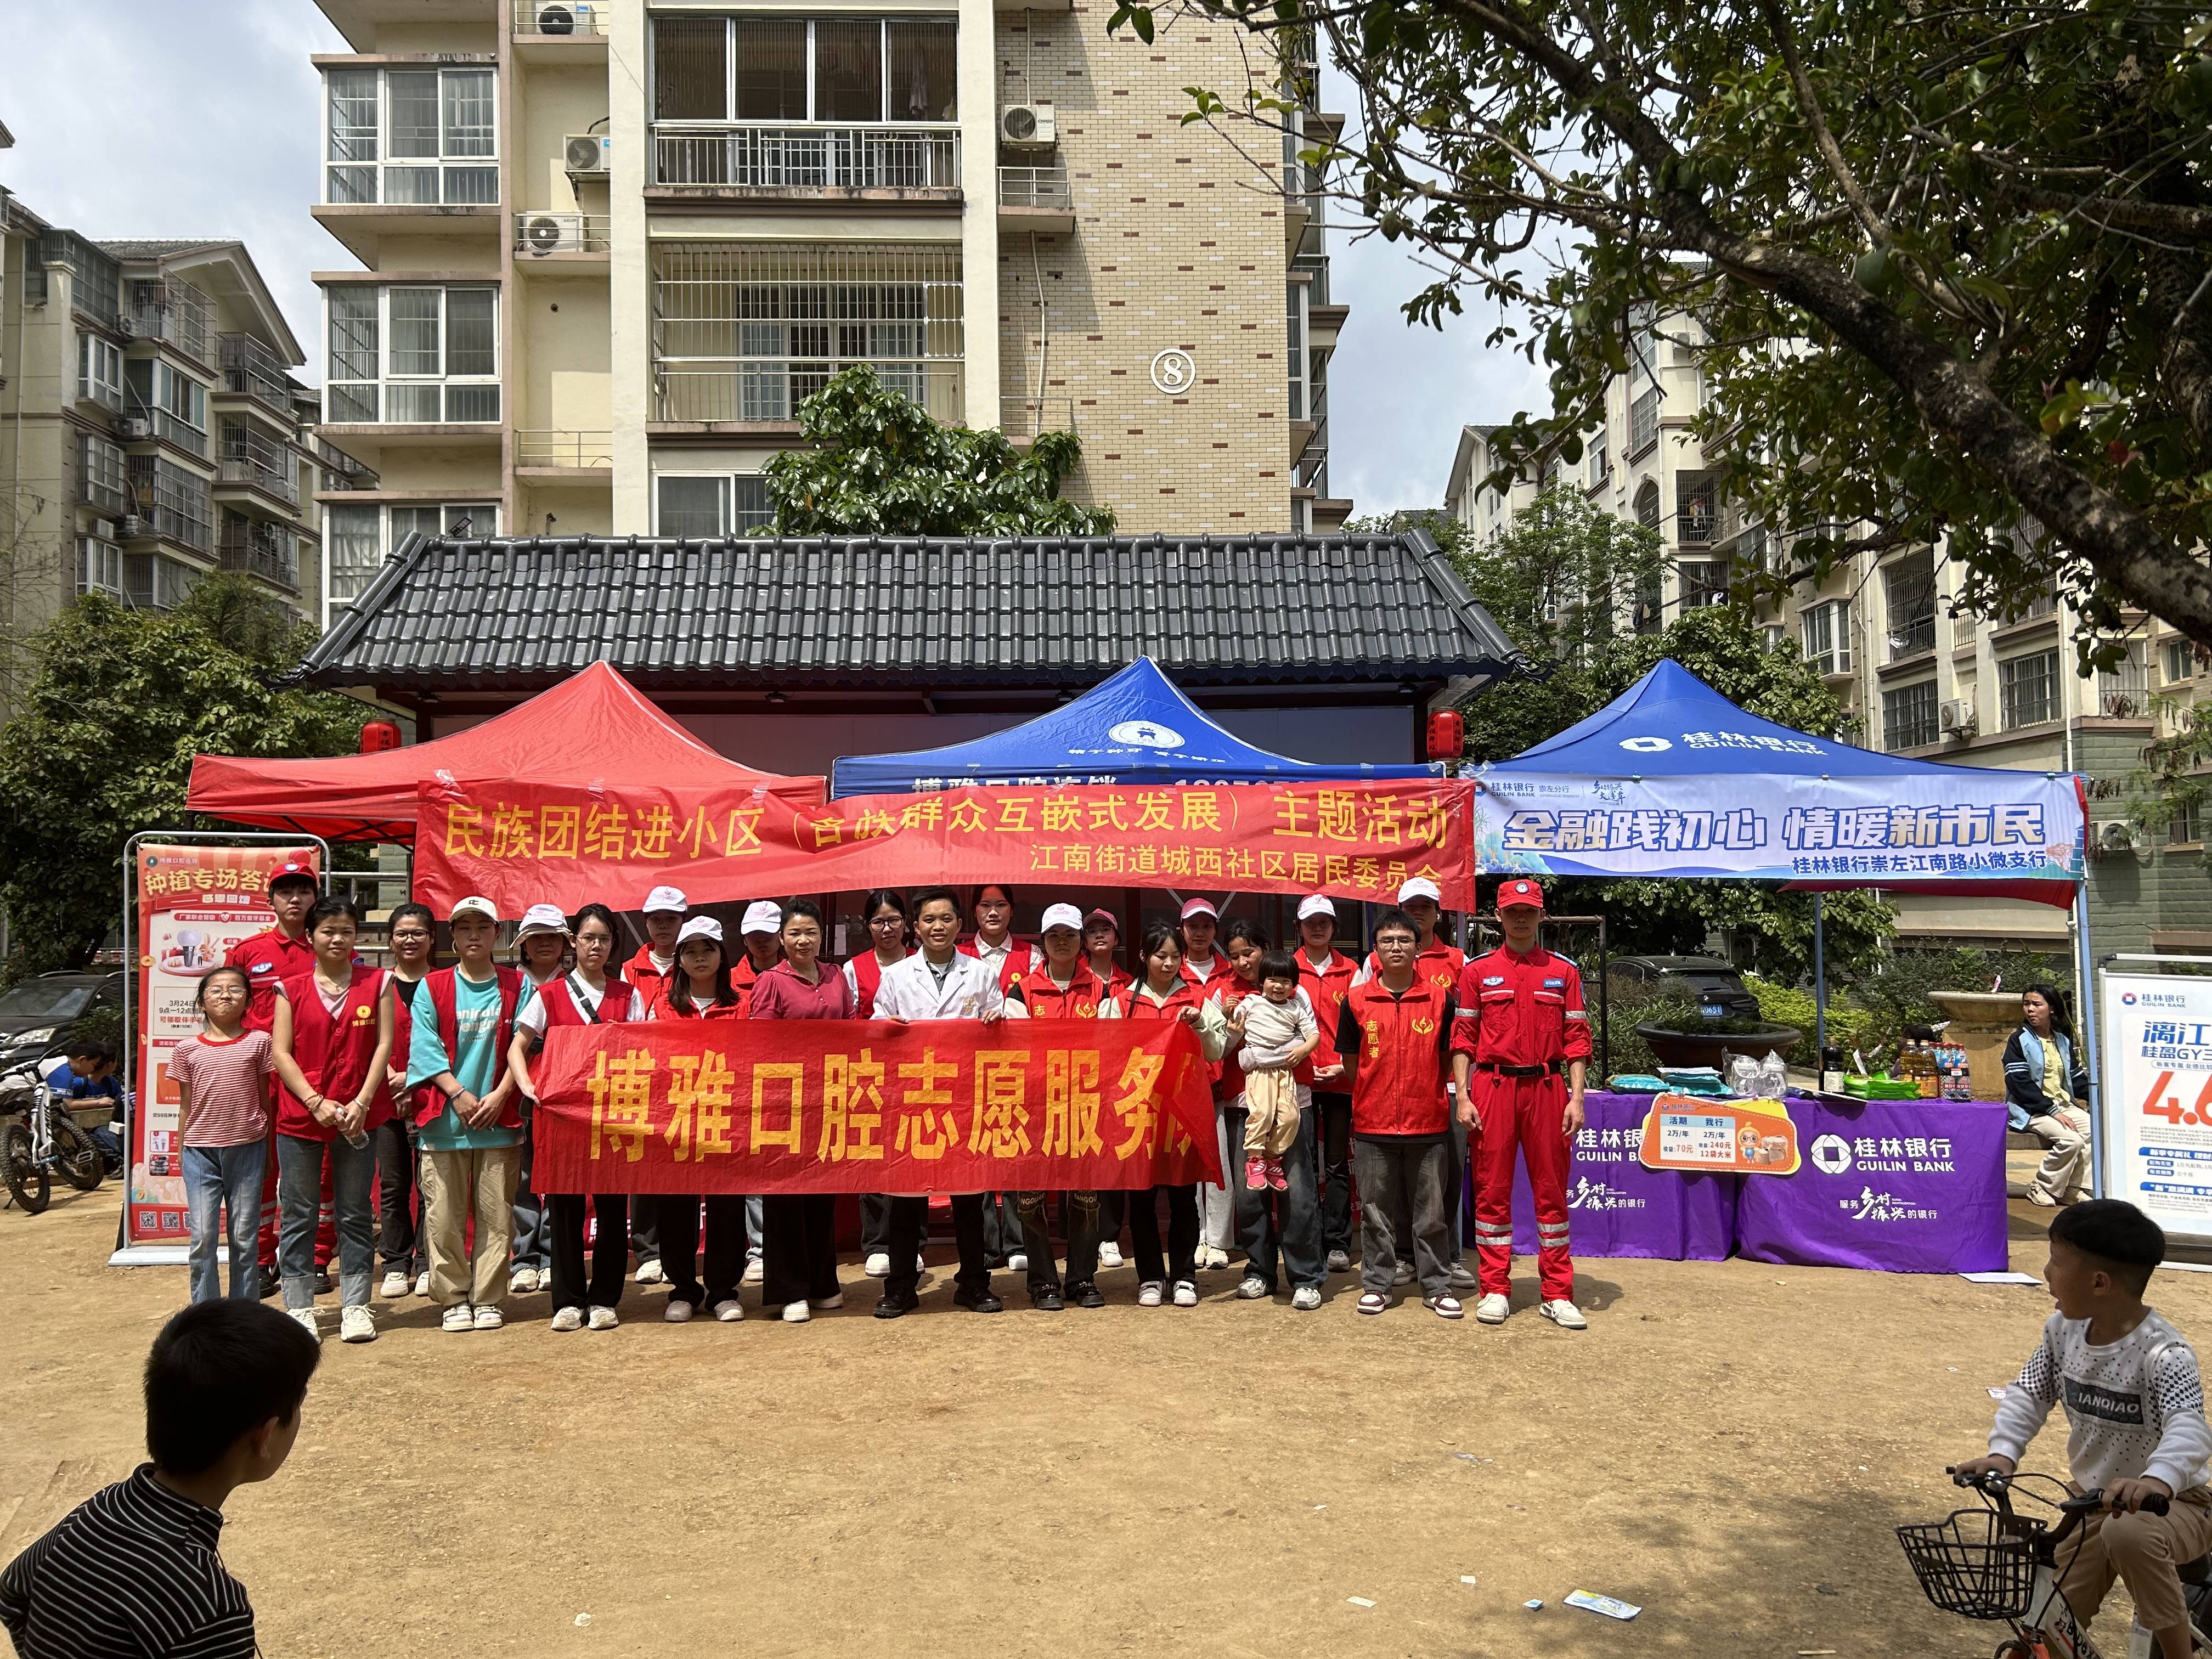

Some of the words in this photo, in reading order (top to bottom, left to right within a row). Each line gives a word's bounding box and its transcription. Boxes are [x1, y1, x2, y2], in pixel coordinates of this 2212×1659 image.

[1163, 357, 1183, 385] 8
[1681, 731, 1817, 749] 桂林银行
[1689, 741, 1762, 750] GUILIN
[1769, 746, 1829, 756] BANK
[1491, 782, 1534, 792] 桂林银行
[1503, 808, 1767, 852] 金融践初心
[1782, 803, 2046, 850] 情暖新市民
[1792, 850, 2047, 875] 桂林银行崇左江南路小微支行
[2142, 994, 2186, 1003] 桂林银行
[1365, 1019, 1380, 1059] 志愿者
[1669, 1116, 1688, 1125] 活期
[1705, 1118, 1724, 1127] 我行
[1576, 1128, 1643, 1148] 桂林银
[1703, 1131, 1725, 1139] 2万/年
[1701, 1150, 1731, 1159] 12袋大米
[1854, 1137, 1951, 1158] 桂林银行
[1576, 1152, 1622, 1161] GUILIN
[1857, 1161, 1906, 1171] GUILIN
[1914, 1161, 1955, 1172] BANK
